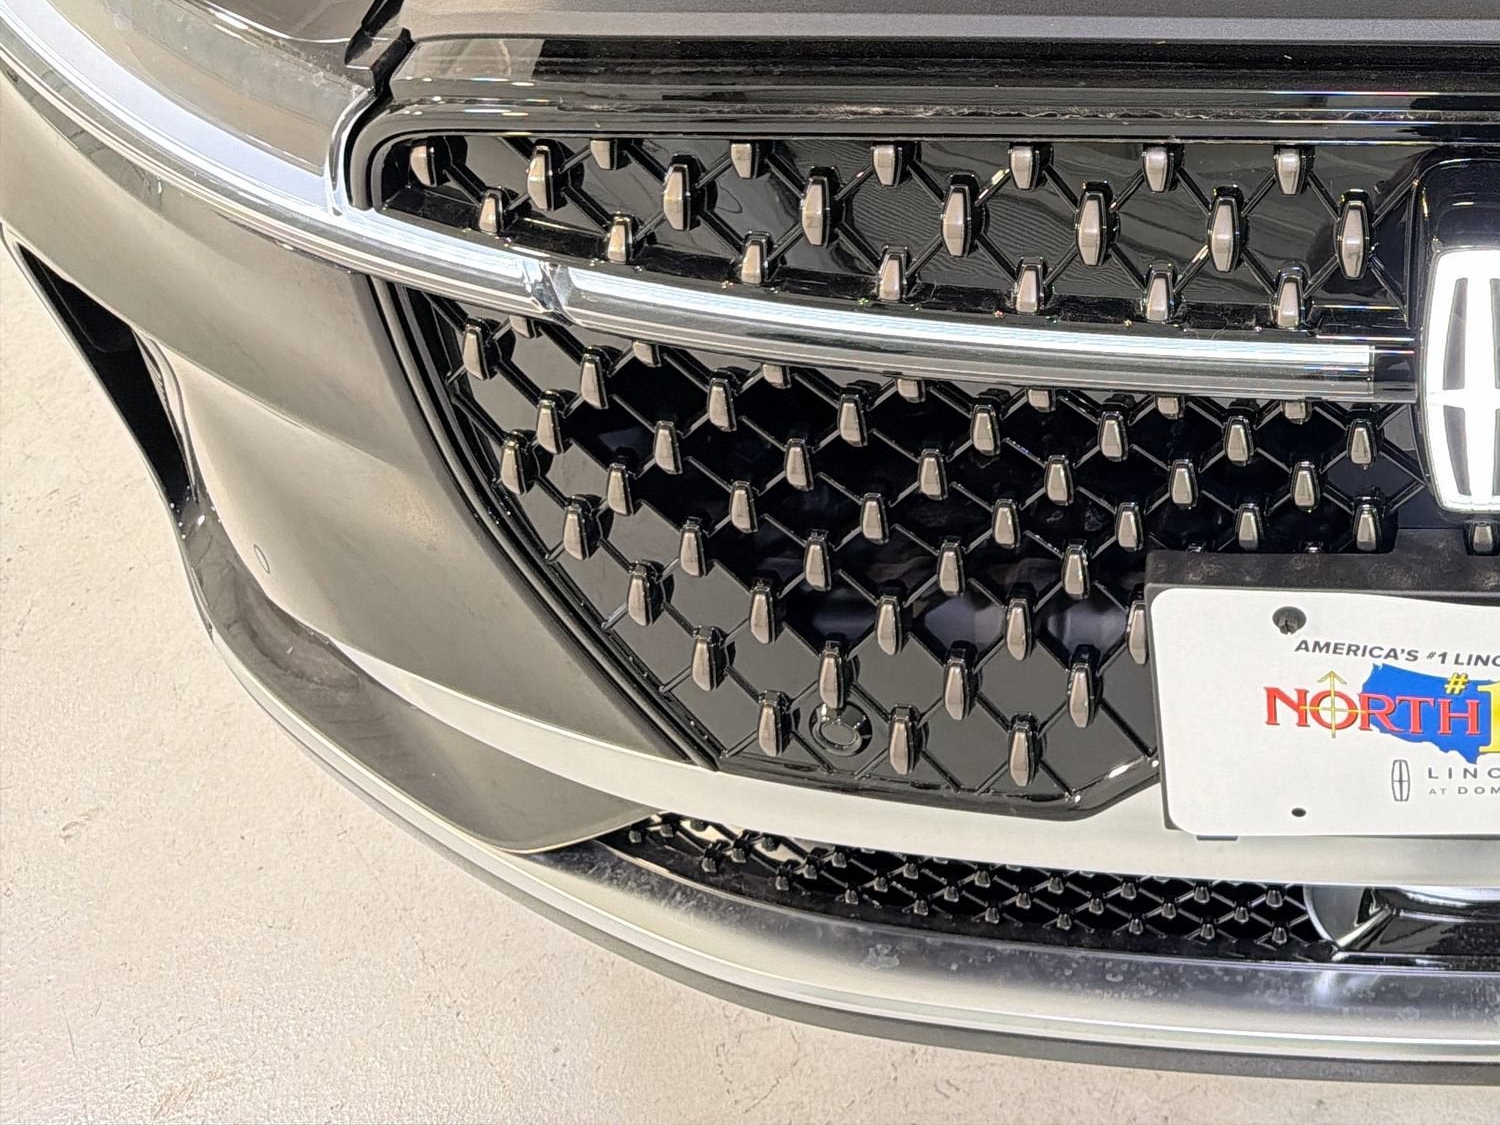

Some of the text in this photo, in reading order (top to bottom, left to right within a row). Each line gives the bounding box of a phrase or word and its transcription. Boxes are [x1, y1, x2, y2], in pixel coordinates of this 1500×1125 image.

[1294, 639, 1420, 662] AMERICA'S
[1425, 650, 1448, 664] #1
[1263, 686, 1481, 736] NORTH
[1428, 787, 1447, 796] AT
